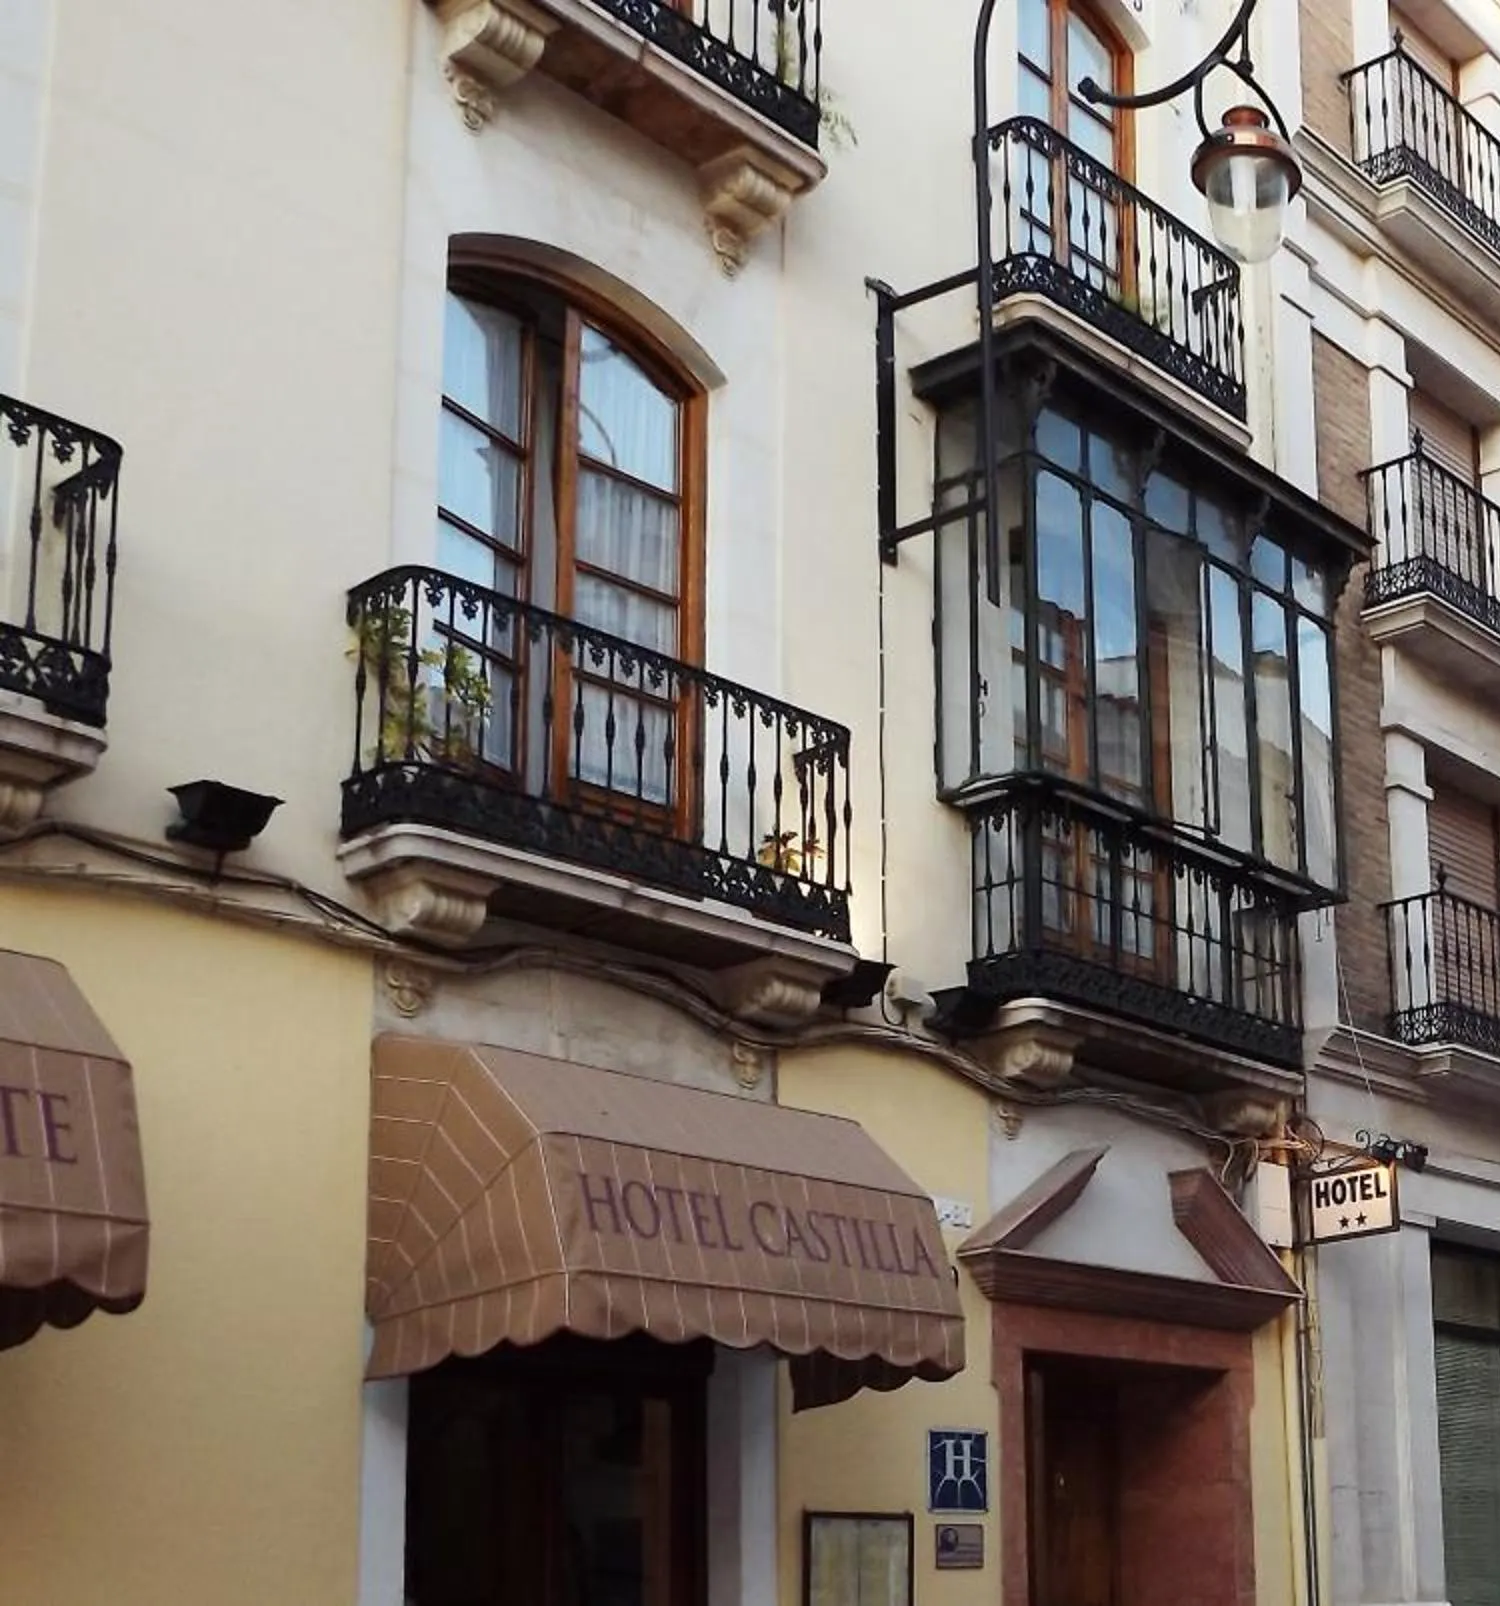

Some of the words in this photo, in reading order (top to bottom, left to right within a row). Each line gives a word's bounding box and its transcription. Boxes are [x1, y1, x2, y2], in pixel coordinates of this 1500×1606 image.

[1315, 1171, 1387, 1209] HOTEL
[577, 1173, 743, 1252] HOTEL
[748, 1200, 940, 1279] CASTILLA
[943, 1439, 973, 1480] H
